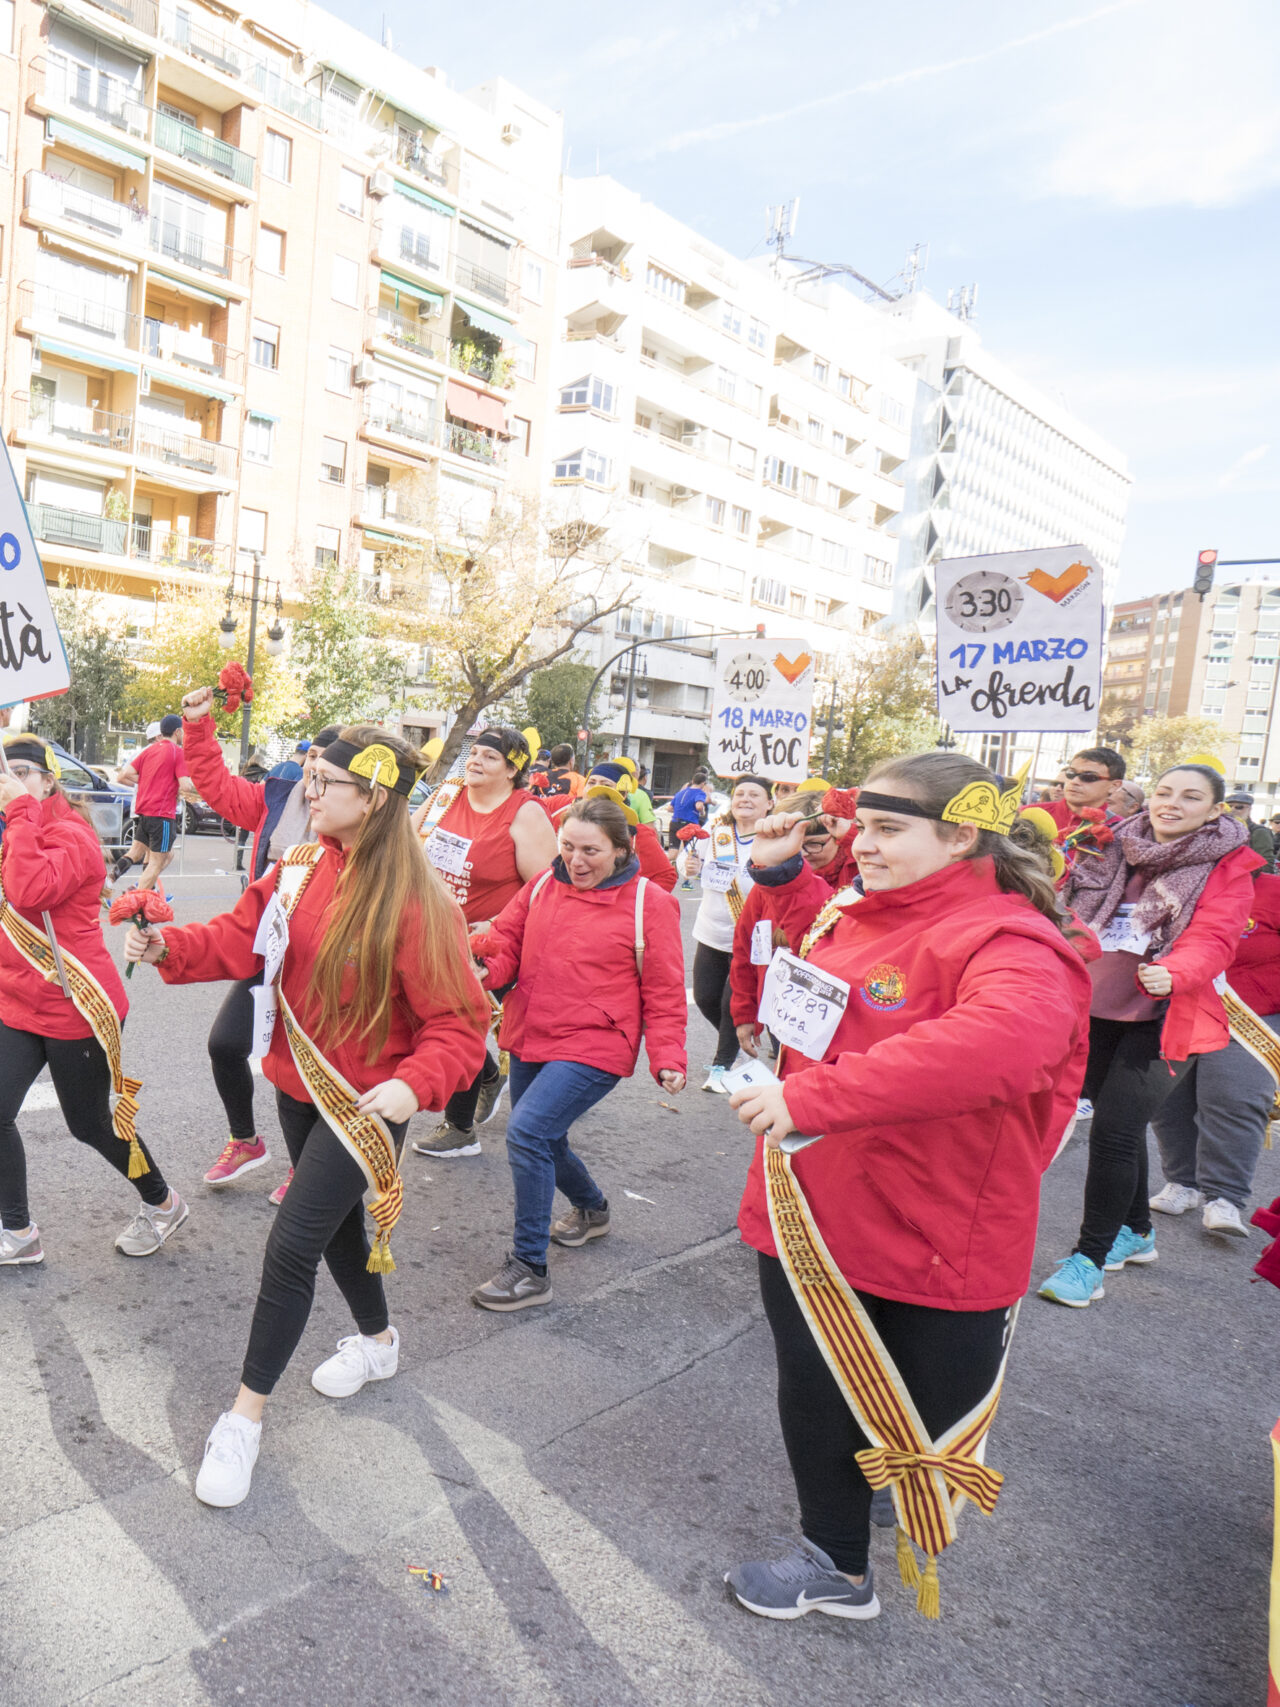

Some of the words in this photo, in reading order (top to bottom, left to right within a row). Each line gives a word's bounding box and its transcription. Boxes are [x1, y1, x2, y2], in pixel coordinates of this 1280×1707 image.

[959, 588, 1012, 617] 3:30
[949, 643, 987, 669] 17
[992, 637, 1089, 665] MARZO
[729, 669, 765, 690] 4:00
[941, 675, 973, 696] LA
[970, 665, 1095, 719] ofrenda
[717, 706, 744, 729] 18
[749, 707, 808, 733] MARZO
[718, 726, 754, 756] nit
[760, 733, 802, 768] FOC
[731, 753, 759, 775] del
